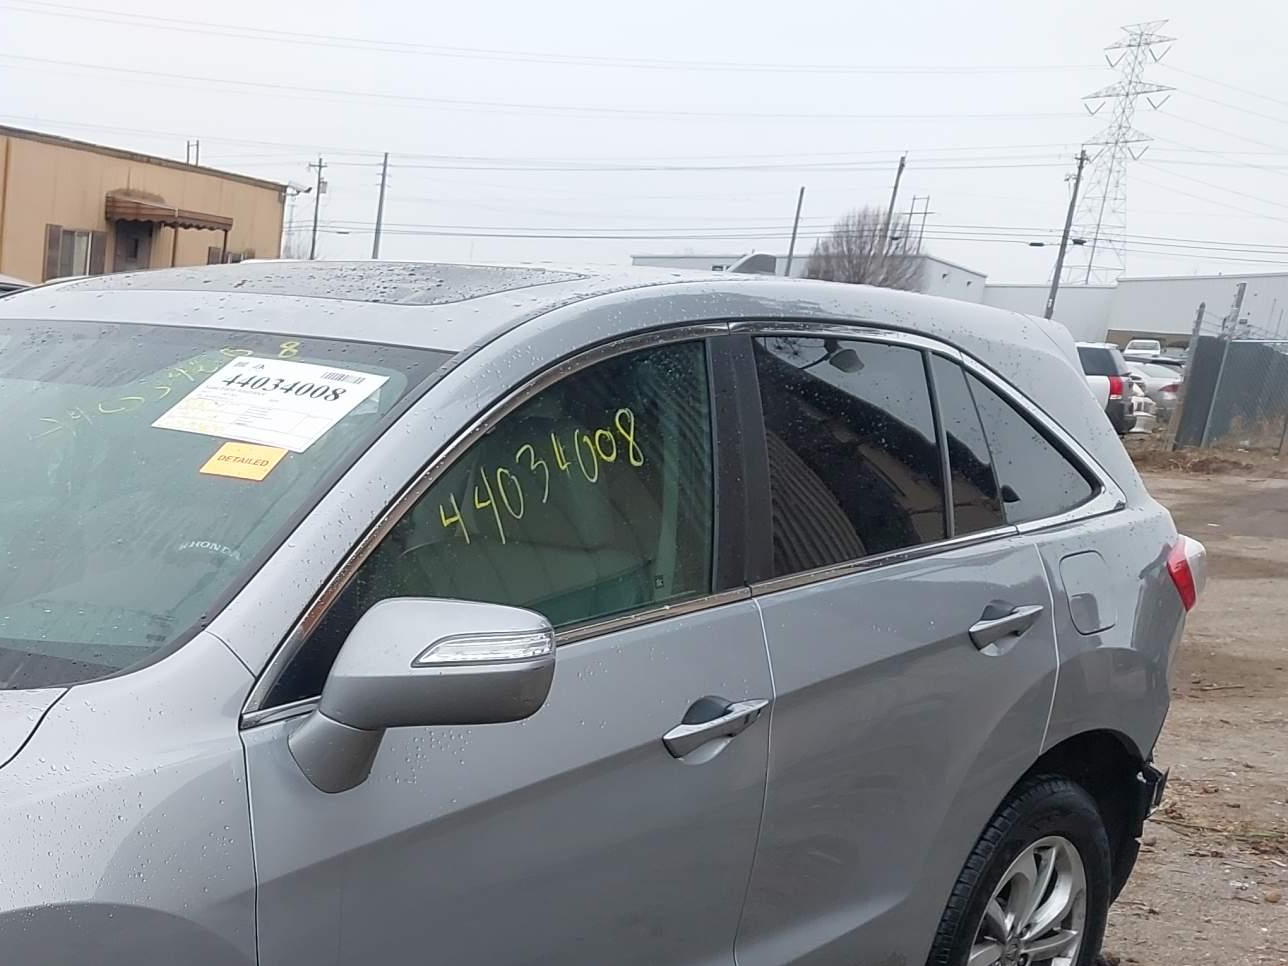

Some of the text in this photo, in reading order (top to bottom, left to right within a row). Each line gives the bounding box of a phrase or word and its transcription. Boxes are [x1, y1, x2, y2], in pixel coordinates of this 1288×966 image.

[221, 373, 347, 402] 44034008
[217, 454, 270, 467] DETAILED
[439, 407, 645, 545] 44034008
